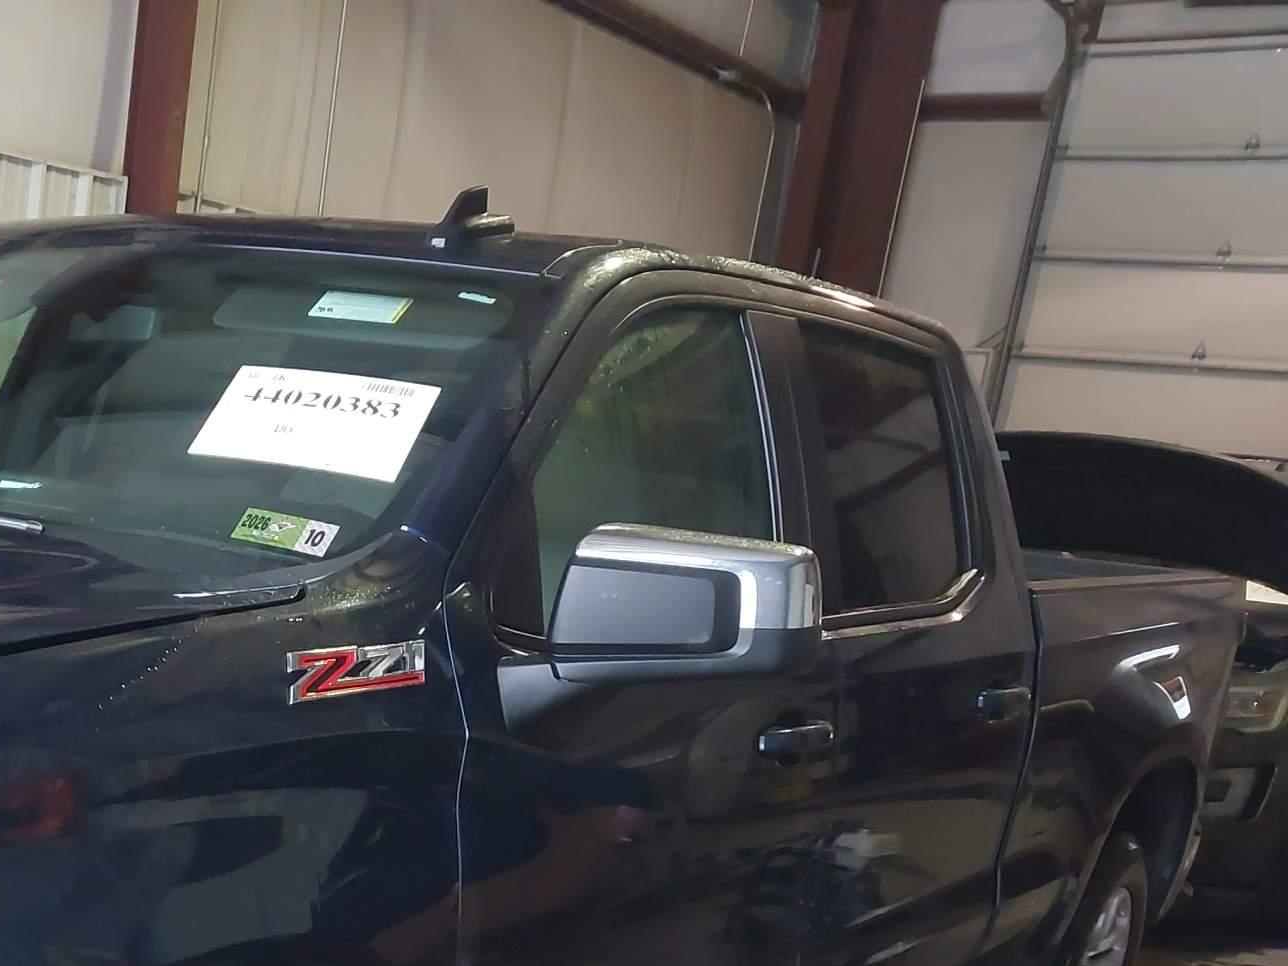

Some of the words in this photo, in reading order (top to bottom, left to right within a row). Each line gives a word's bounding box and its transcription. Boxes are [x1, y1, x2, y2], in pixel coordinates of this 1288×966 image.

[244, 387, 401, 418] 44020383
[241, 513, 272, 531] 2026
[304, 529, 326, 547] 10
[287, 639, 425, 705] Z71
